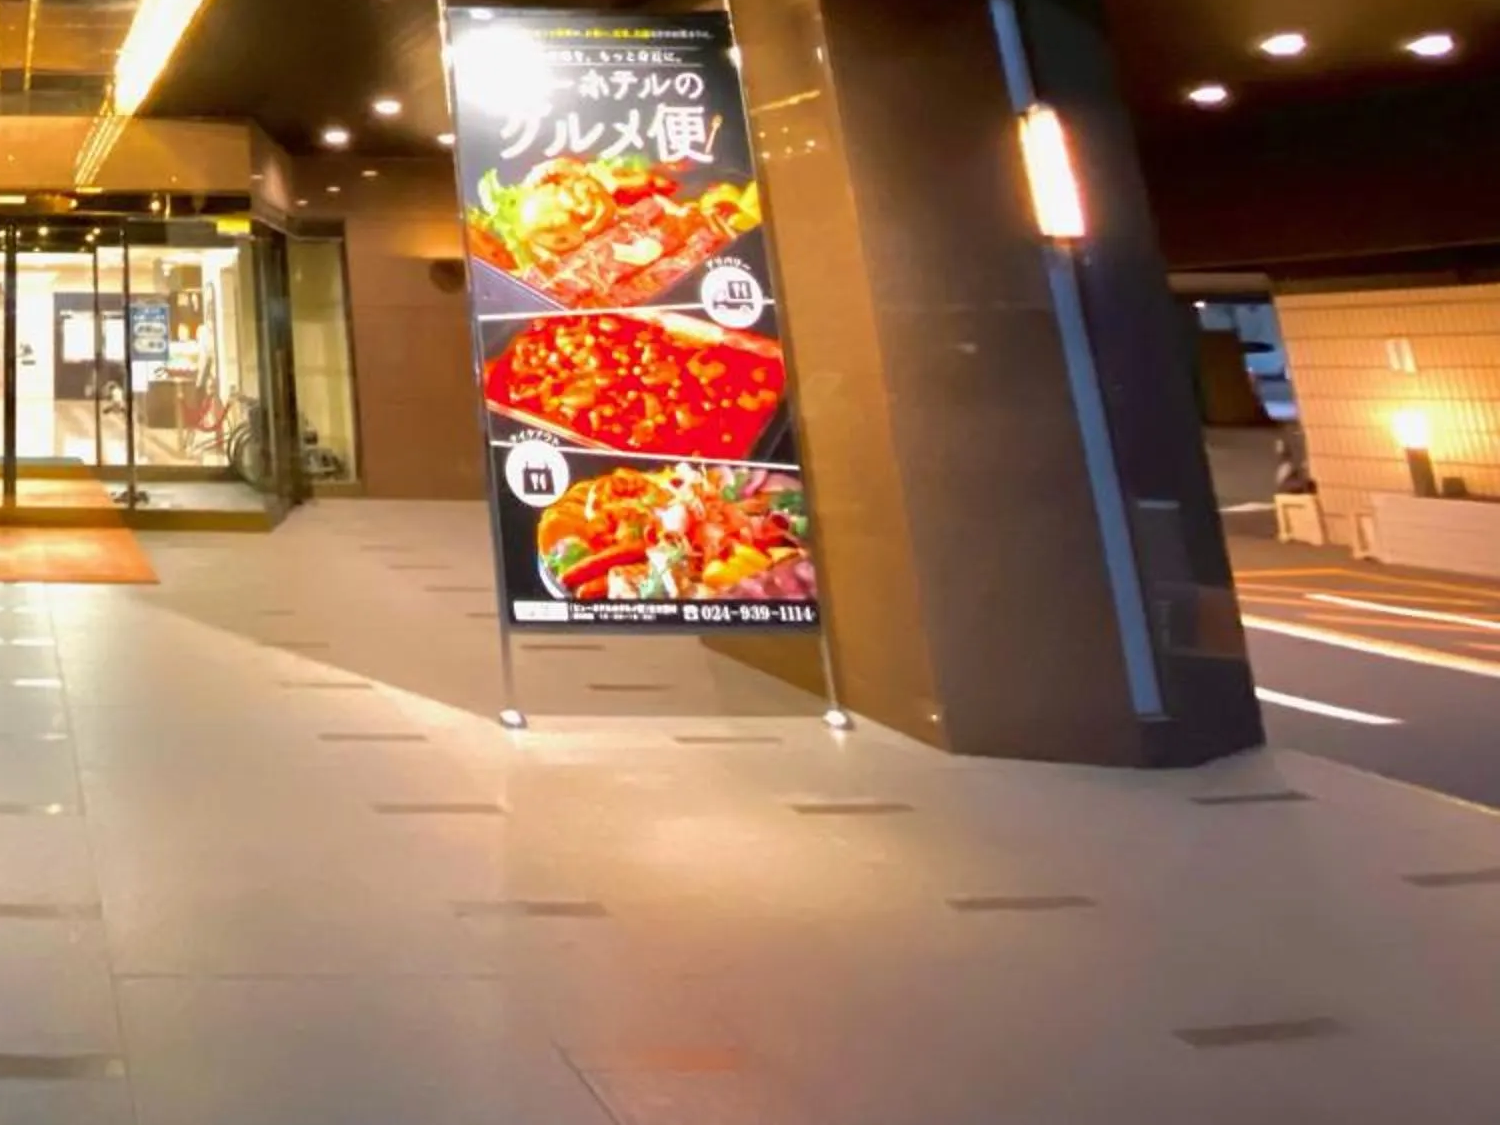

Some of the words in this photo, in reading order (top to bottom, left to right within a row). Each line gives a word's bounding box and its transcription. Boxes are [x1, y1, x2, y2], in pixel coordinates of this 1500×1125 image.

[546, 69, 704, 101] ーホテルの
[701, 604, 816, 622] 024-939-1114
